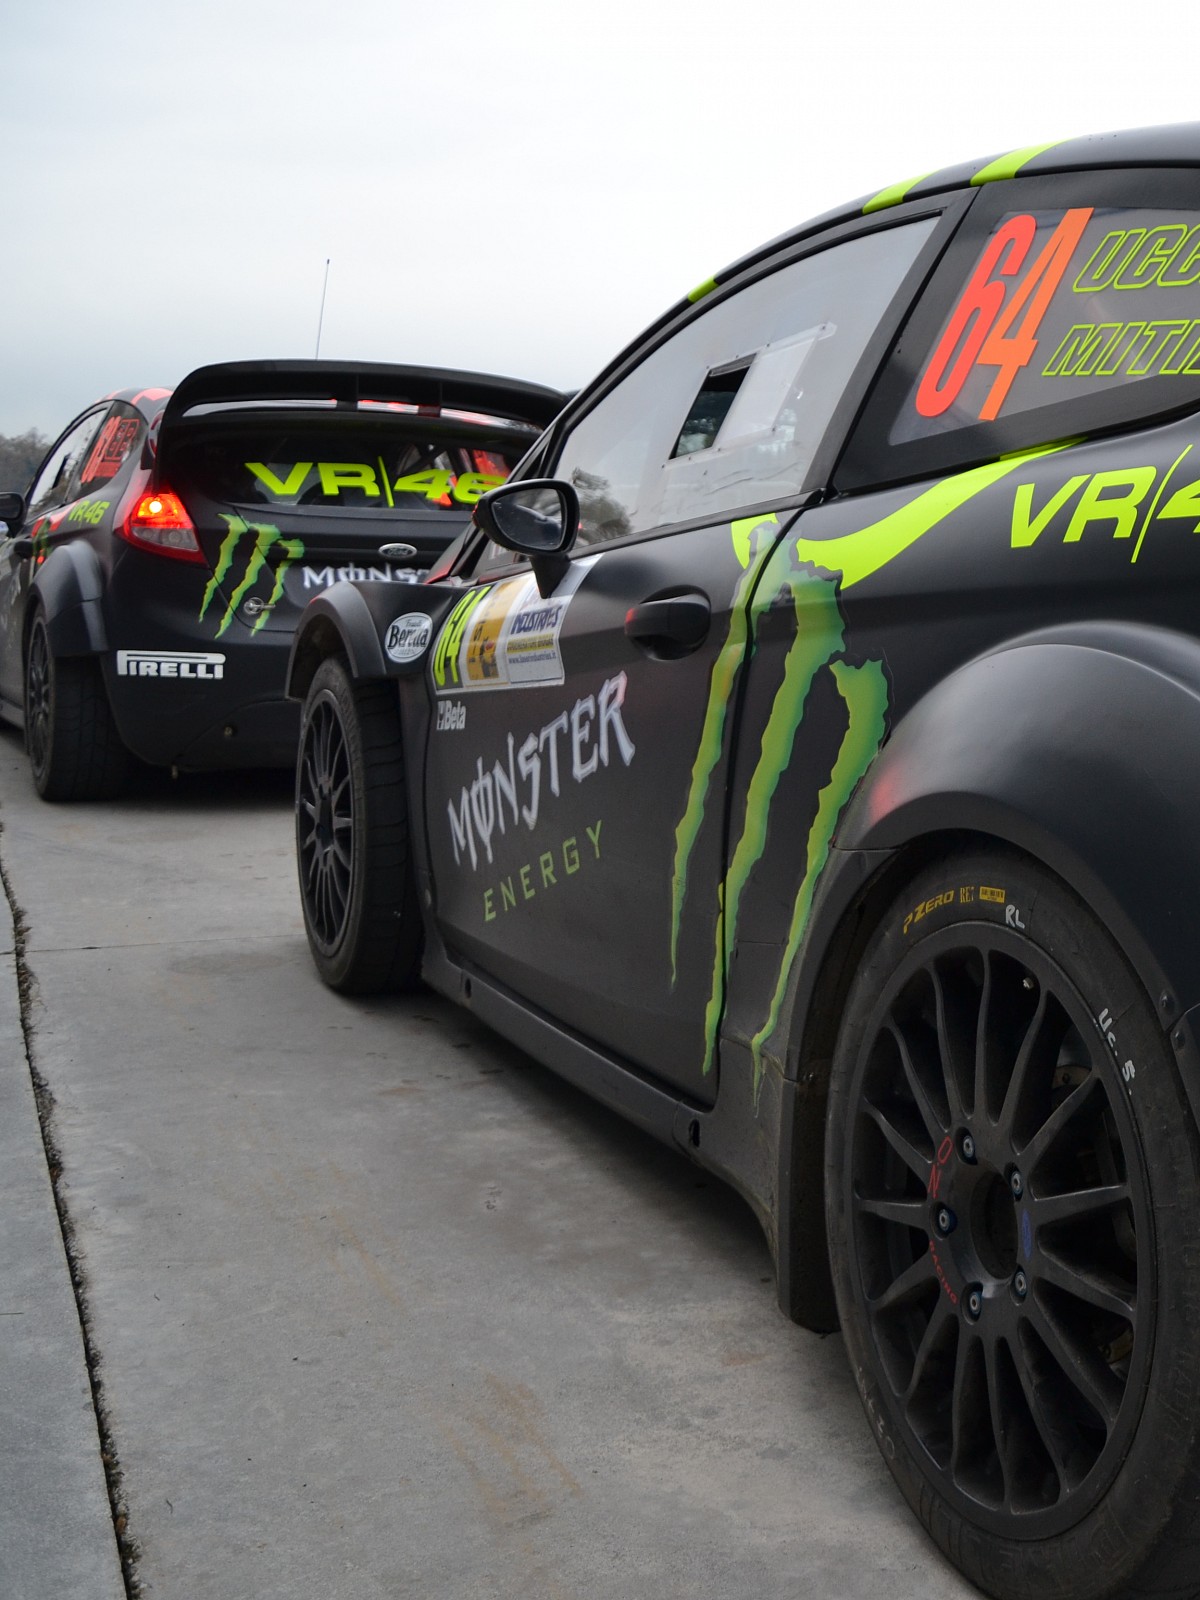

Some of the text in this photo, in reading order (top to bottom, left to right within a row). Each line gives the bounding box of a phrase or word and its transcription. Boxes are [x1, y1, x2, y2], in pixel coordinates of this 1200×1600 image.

[915, 207, 1094, 421] 64
[116, 650, 227, 680] PIRELLI
[447, 670, 636, 872] MONSTER
[484, 820, 602, 922] ENERGY
[913, 889, 955, 924] ZERO
